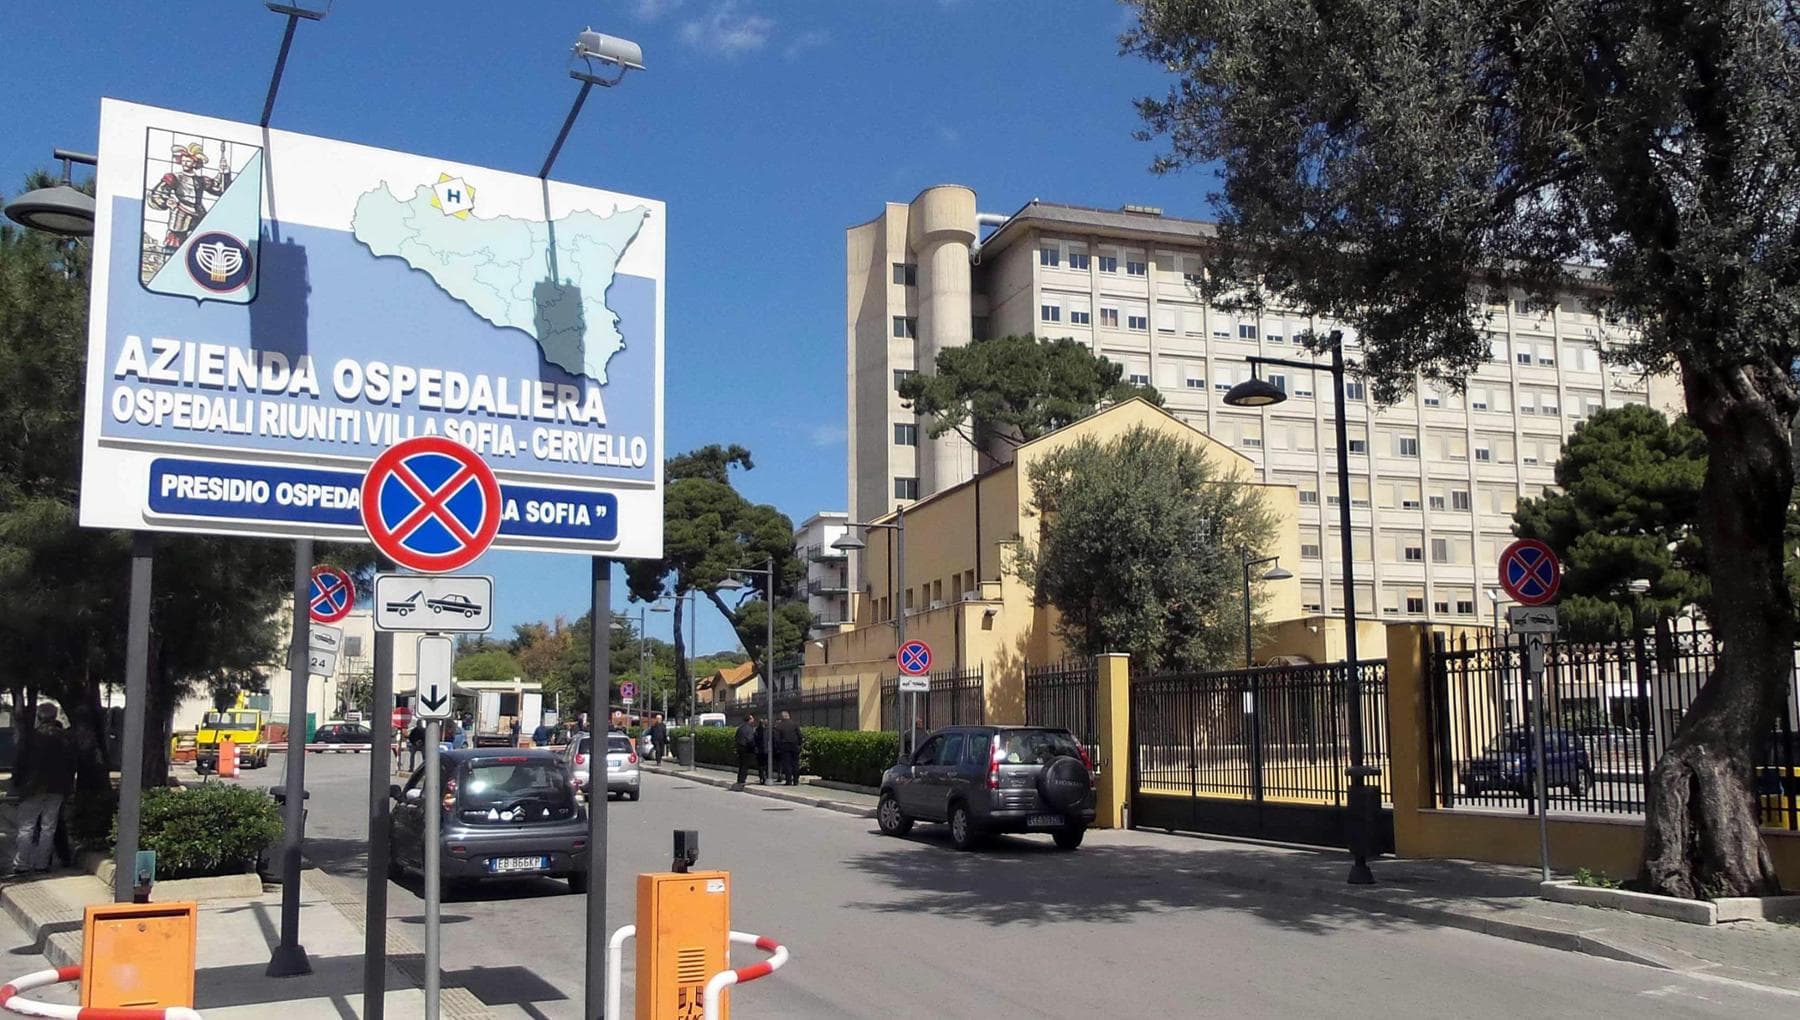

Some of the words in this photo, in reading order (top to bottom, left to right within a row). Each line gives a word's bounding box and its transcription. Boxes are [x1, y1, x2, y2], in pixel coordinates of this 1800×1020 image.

[447, 188, 460, 204] H
[114, 335, 320, 398] AZIENDA
[332, 358, 607, 424] OSPEDALIERA
[111, 385, 254, 435] OSPEDALI
[260, 400, 361, 444] RIUNITI
[365, 410, 438, 446] VILLA
[444, 417, 517, 457] SOFIA
[532, 427, 648, 468] CERVELLO
[160, 473, 271, 504] PRESIDIO
[275, 481, 361, 511] OSPEDA
[525, 500, 592, 526] SOFIA
